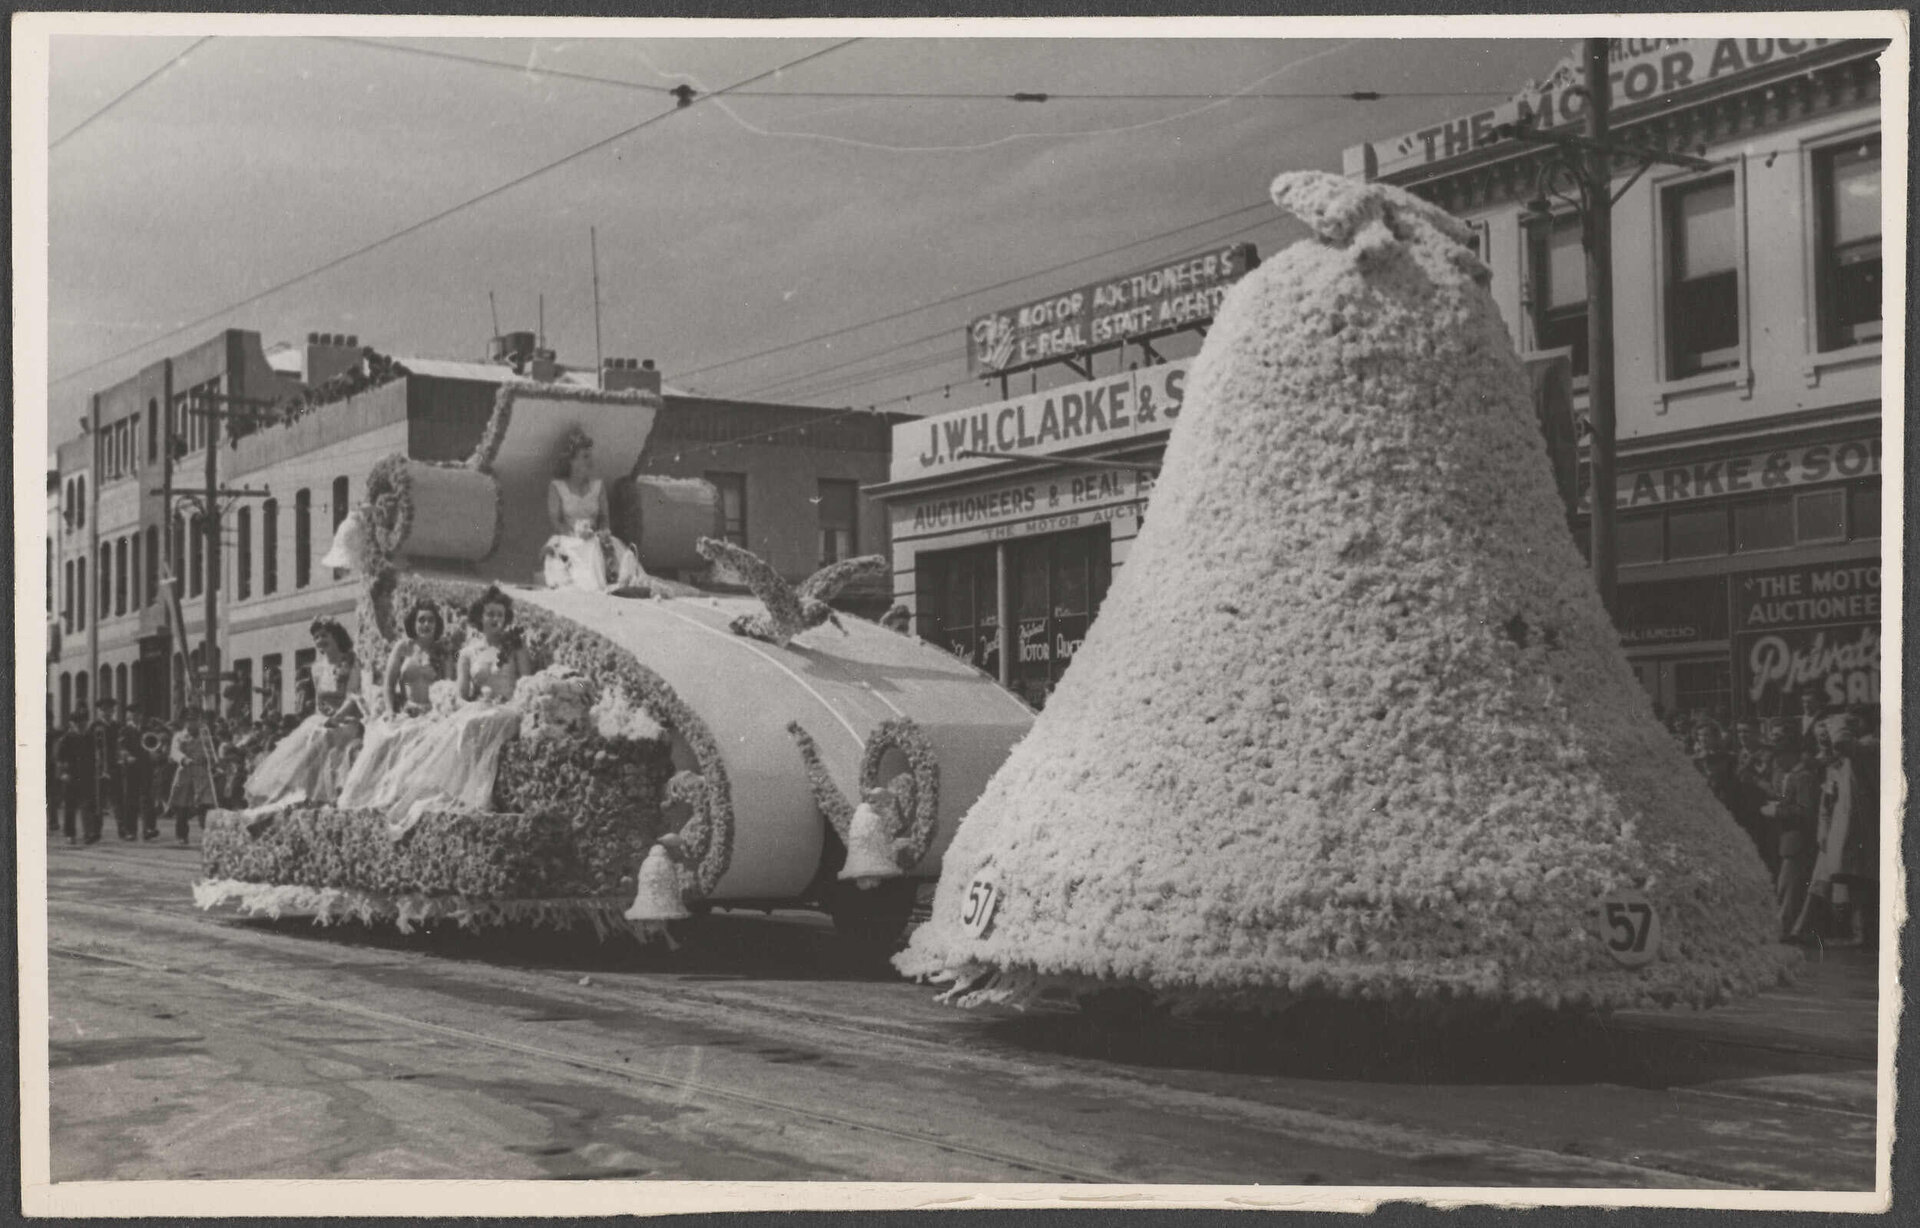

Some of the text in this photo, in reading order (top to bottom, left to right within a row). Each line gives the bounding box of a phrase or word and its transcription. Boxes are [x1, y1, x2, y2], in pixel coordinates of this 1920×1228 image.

[1137, 384, 1157, 424] &
[1616, 458, 1753, 507] ARKE
[1762, 450, 1792, 489] &
[913, 485, 1036, 530] AUCTIONEERS
[1071, 471, 1125, 503] REAL
[1026, 514, 1079, 532] MOTOR
[1811, 566, 1881, 592] MOTO
[1747, 594, 1881, 625] AUCTIONEE
[964, 881, 994, 926] 57
[1604, 902, 1652, 953] 57
